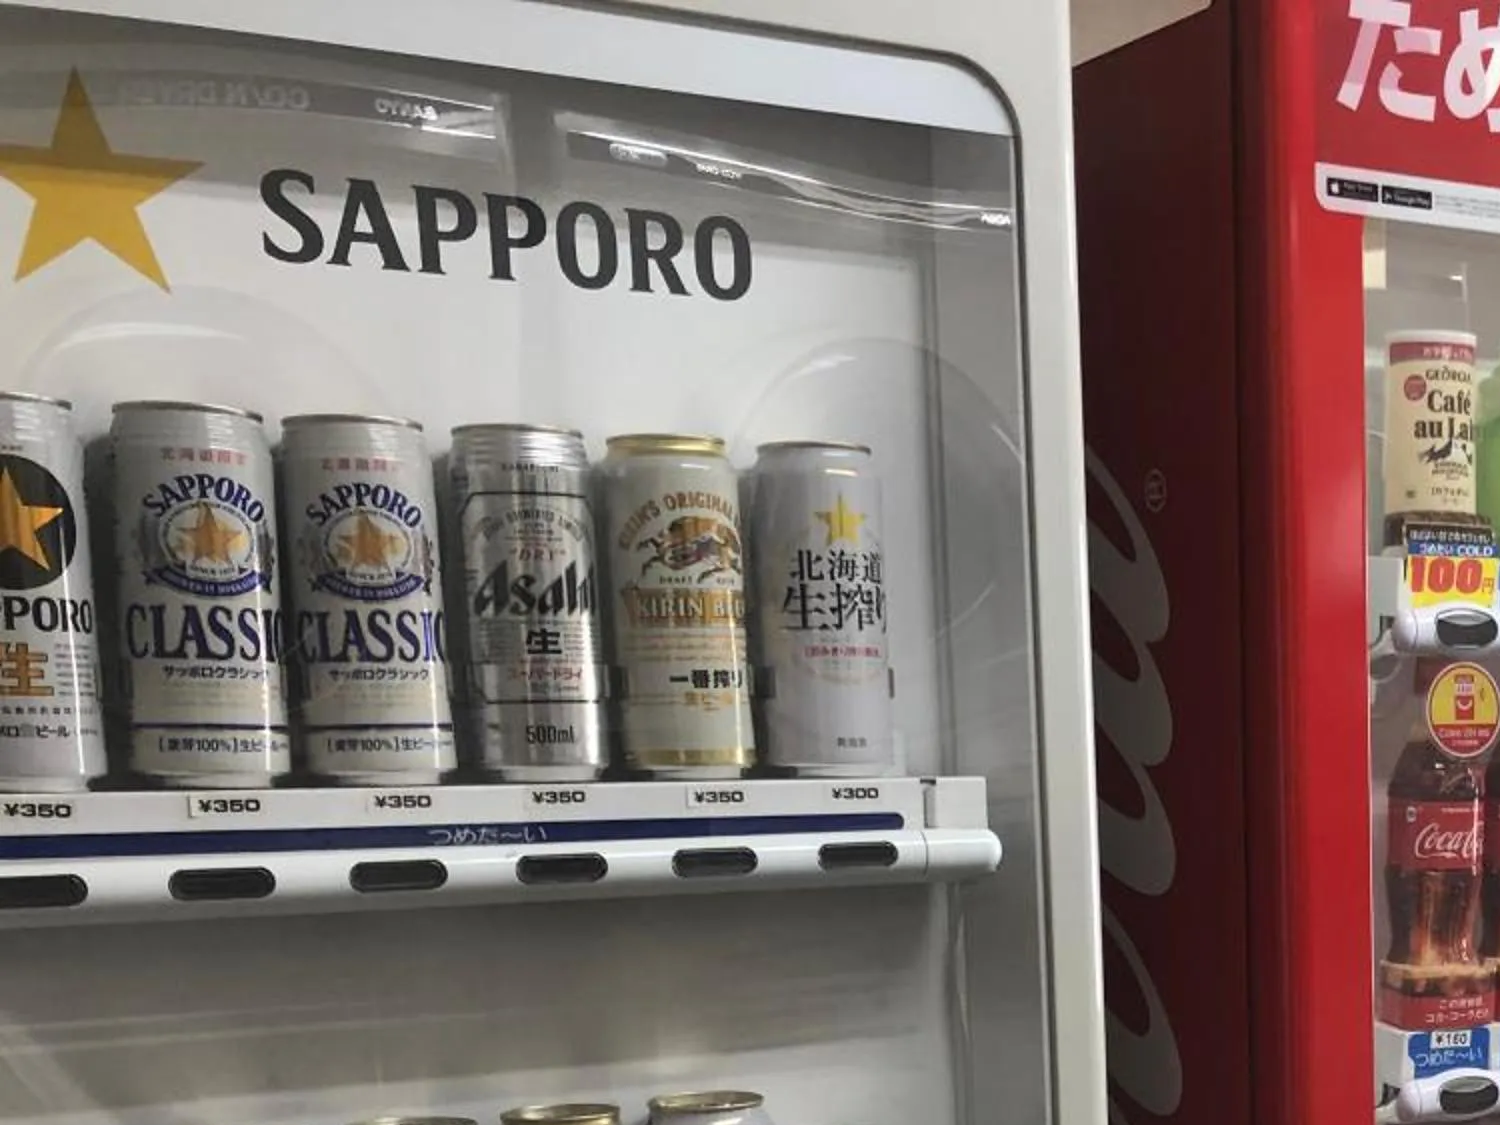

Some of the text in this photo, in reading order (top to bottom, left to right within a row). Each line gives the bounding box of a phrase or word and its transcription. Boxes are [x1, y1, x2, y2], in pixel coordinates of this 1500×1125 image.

[259, 168, 753, 302] SAPPORO
[1414, 422, 1443, 440] au
[142, 473, 266, 524] SAPPORO
[306, 482, 422, 528] SAPPORO
[1456, 544, 1494, 557] COLD
[790, 549, 883, 584] 北海道
[0, 595, 93, 635] PORO
[526, 629, 563, 656] 生
[668, 668, 744, 690] 一番搾り
[375, 793, 433, 809] ¥350
[532, 789, 586, 805] ¥350
[694, 789, 745, 804] ¥350
[831, 786, 880, 801] ¥300
[4, 802, 72, 820] ¥350
[198, 798, 262, 815] ¥350
